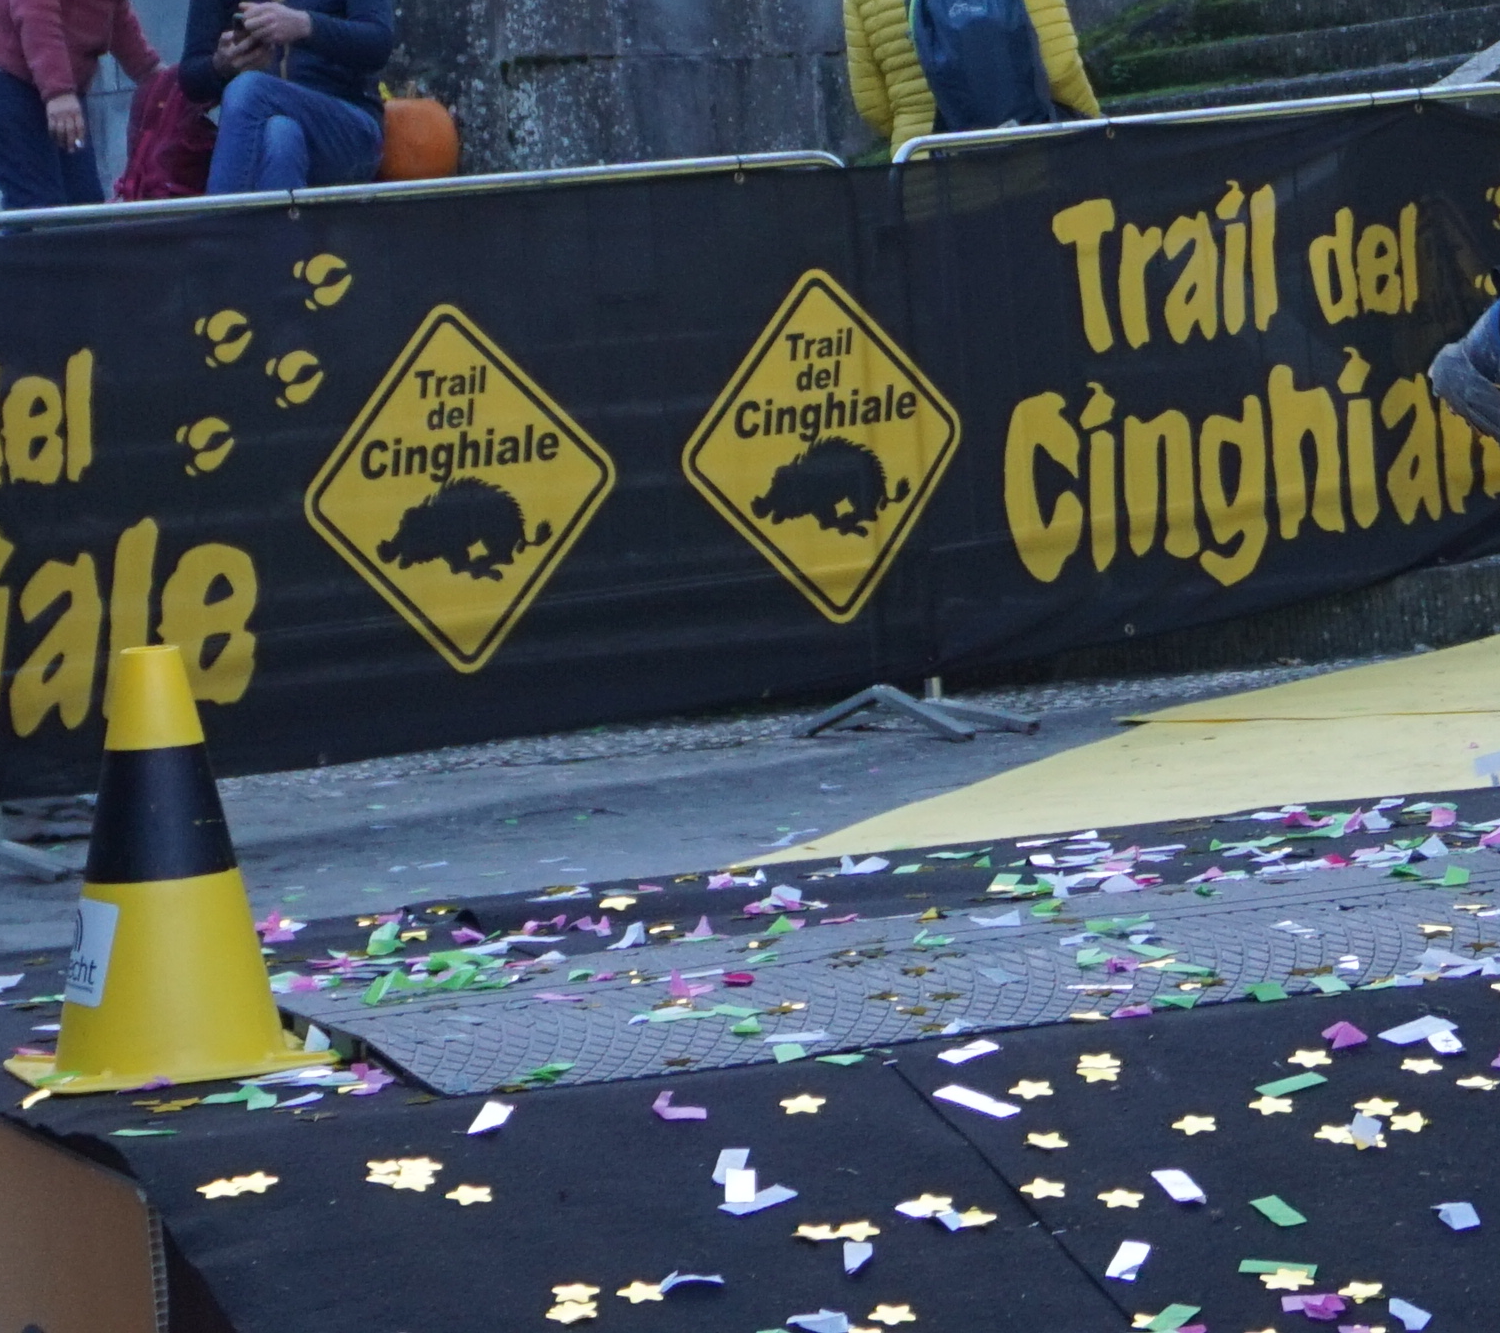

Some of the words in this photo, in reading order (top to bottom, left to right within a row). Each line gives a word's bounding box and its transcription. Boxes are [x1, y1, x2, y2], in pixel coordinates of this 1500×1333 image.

[1052, 178, 1277, 354] Trail
[1308, 201, 1420, 326] del
[784, 325, 854, 365] Trail
[414, 365, 487, 400] Trail
[796, 356, 841, 392] del
[426, 395, 475, 430] del
[734, 382, 918, 445] Cinghiale
[360, 422, 560, 485] Cinghiale
